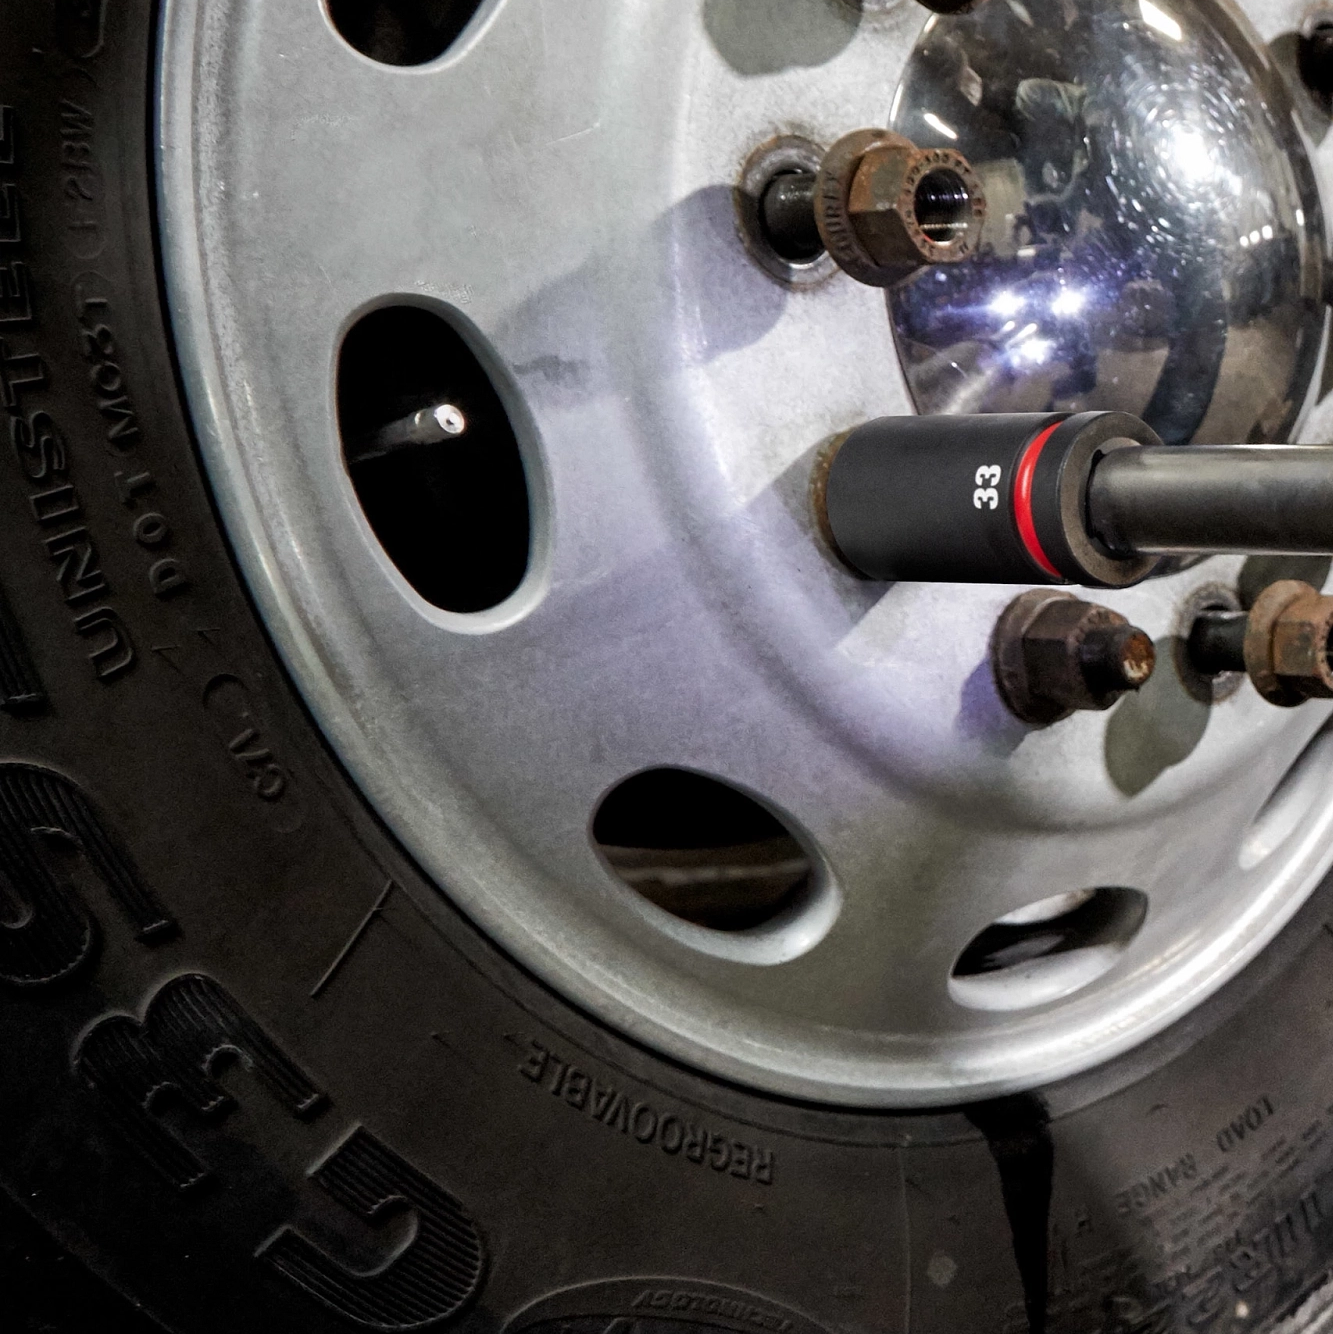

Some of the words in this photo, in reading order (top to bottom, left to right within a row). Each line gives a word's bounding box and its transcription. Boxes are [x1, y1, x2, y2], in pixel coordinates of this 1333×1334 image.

[113, 470, 187, 598] DOT
[973, 464, 1001, 509] 33
[517, 1038, 776, 1184] REGROOVABLE
